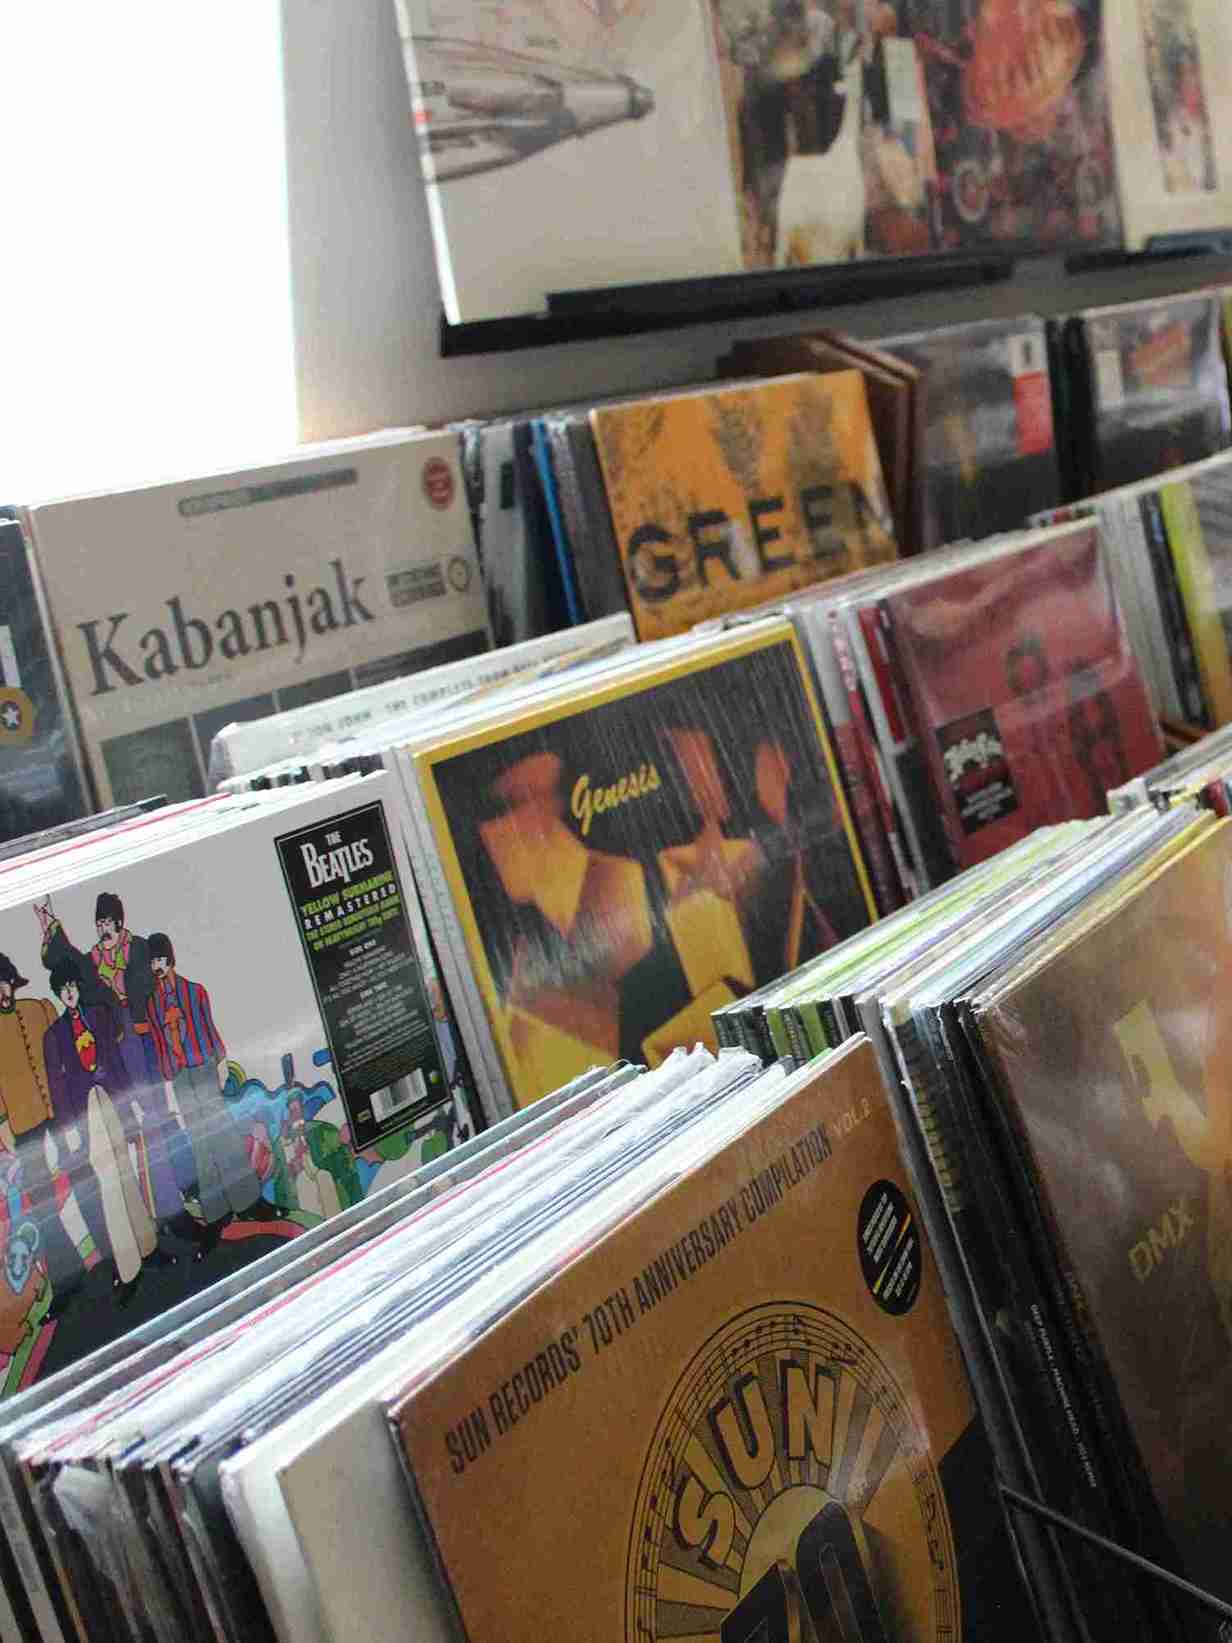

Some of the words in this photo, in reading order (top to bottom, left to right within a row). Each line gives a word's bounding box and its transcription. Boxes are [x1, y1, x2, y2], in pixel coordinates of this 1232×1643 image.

[76, 558, 376, 696] Kabanjak
[325, 830, 343, 846] THE
[571, 762, 662, 836] Genesis
[300, 838, 375, 888] BEATLES
[303, 883, 397, 930] REMASTERED
[1128, 1195, 1195, 1284] DMX
[445, 1415, 491, 1473] SUN
[488, 1331, 581, 1434] RECORDS'
[581, 1285, 631, 1354] 70TH
[631, 1197, 741, 1318] ANNIVERSARY
[738, 1123, 833, 1224] COMPILATION
[671, 1358, 839, 1570] SUN
